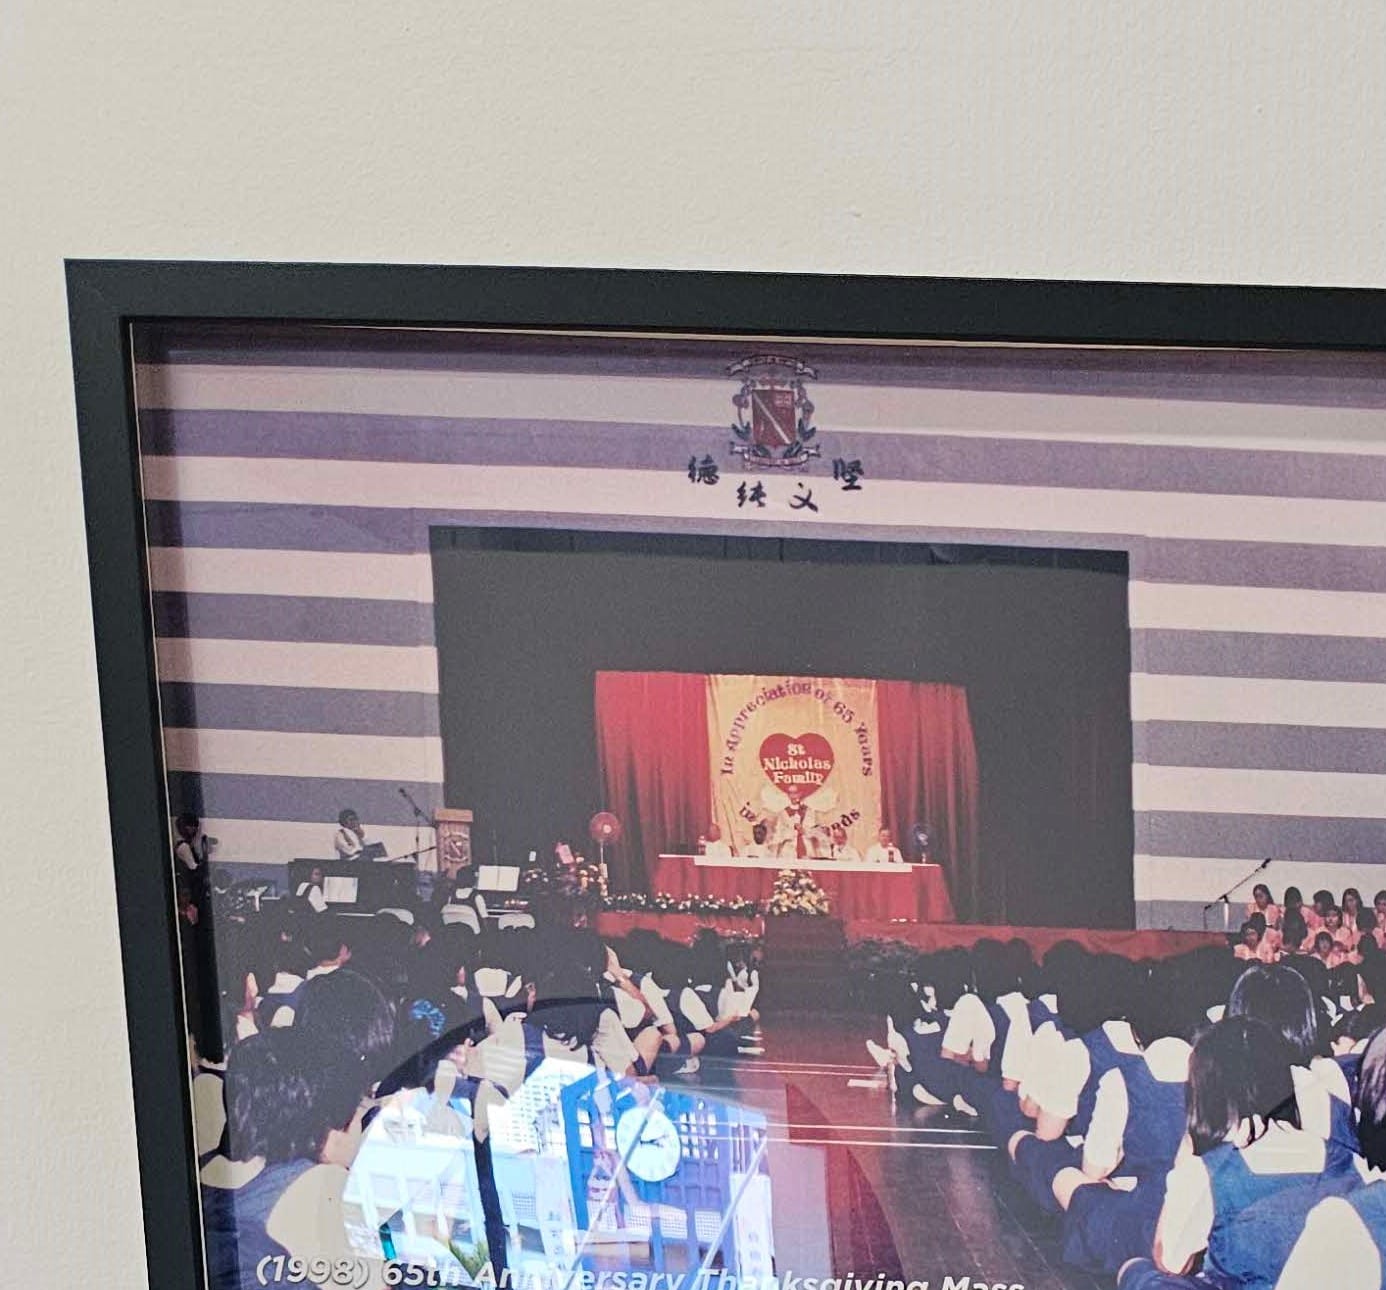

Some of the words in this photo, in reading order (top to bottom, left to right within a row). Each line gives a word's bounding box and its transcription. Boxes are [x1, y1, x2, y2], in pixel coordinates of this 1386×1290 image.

[833, 701, 856, 724] 65
[787, 743, 806, 756] St
[762, 757, 832, 771] Nicholas
[773, 771, 824, 785] Family
[256, 1255, 370, 1290] (1998)
[381, 1256, 459, 1287] 65th
